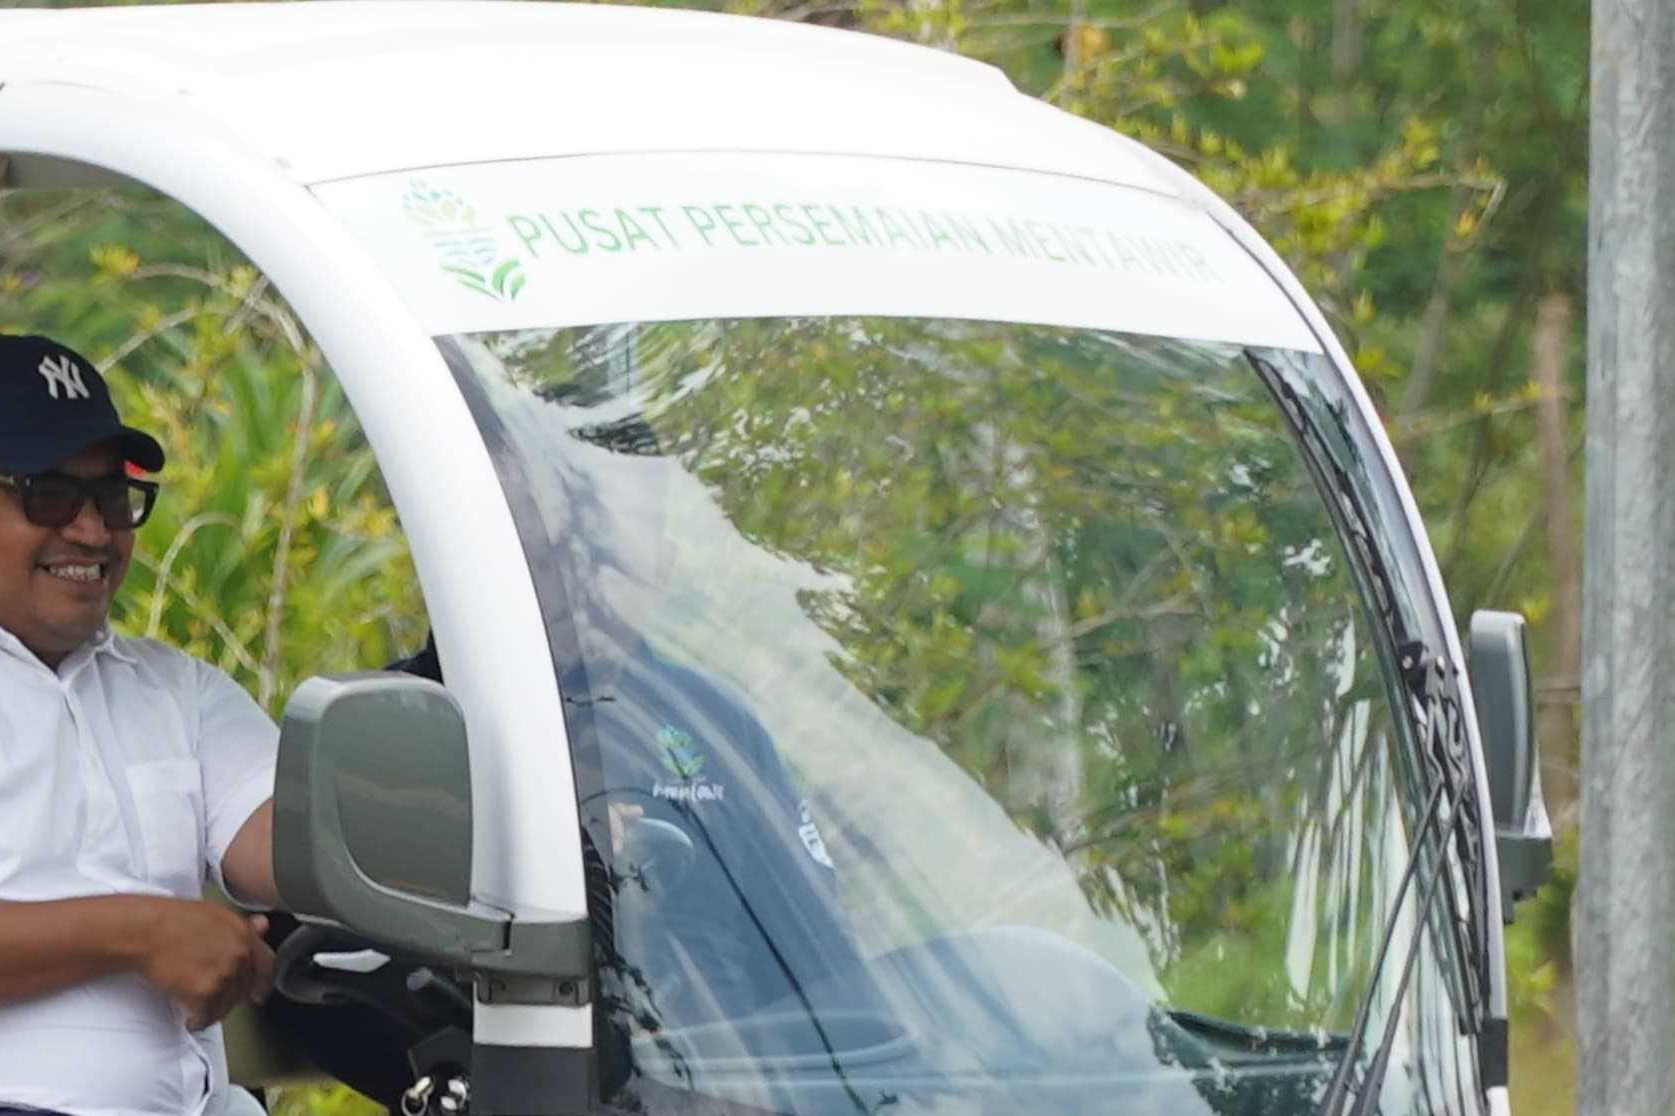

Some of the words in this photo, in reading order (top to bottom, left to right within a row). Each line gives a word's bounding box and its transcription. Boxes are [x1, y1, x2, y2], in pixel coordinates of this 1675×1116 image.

[506, 206, 680, 258] PUSAT
[679, 202, 993, 255] PERSEMAIAN
[982, 213, 1226, 286] MENTAWIR
[38, 355, 91, 399] NY
